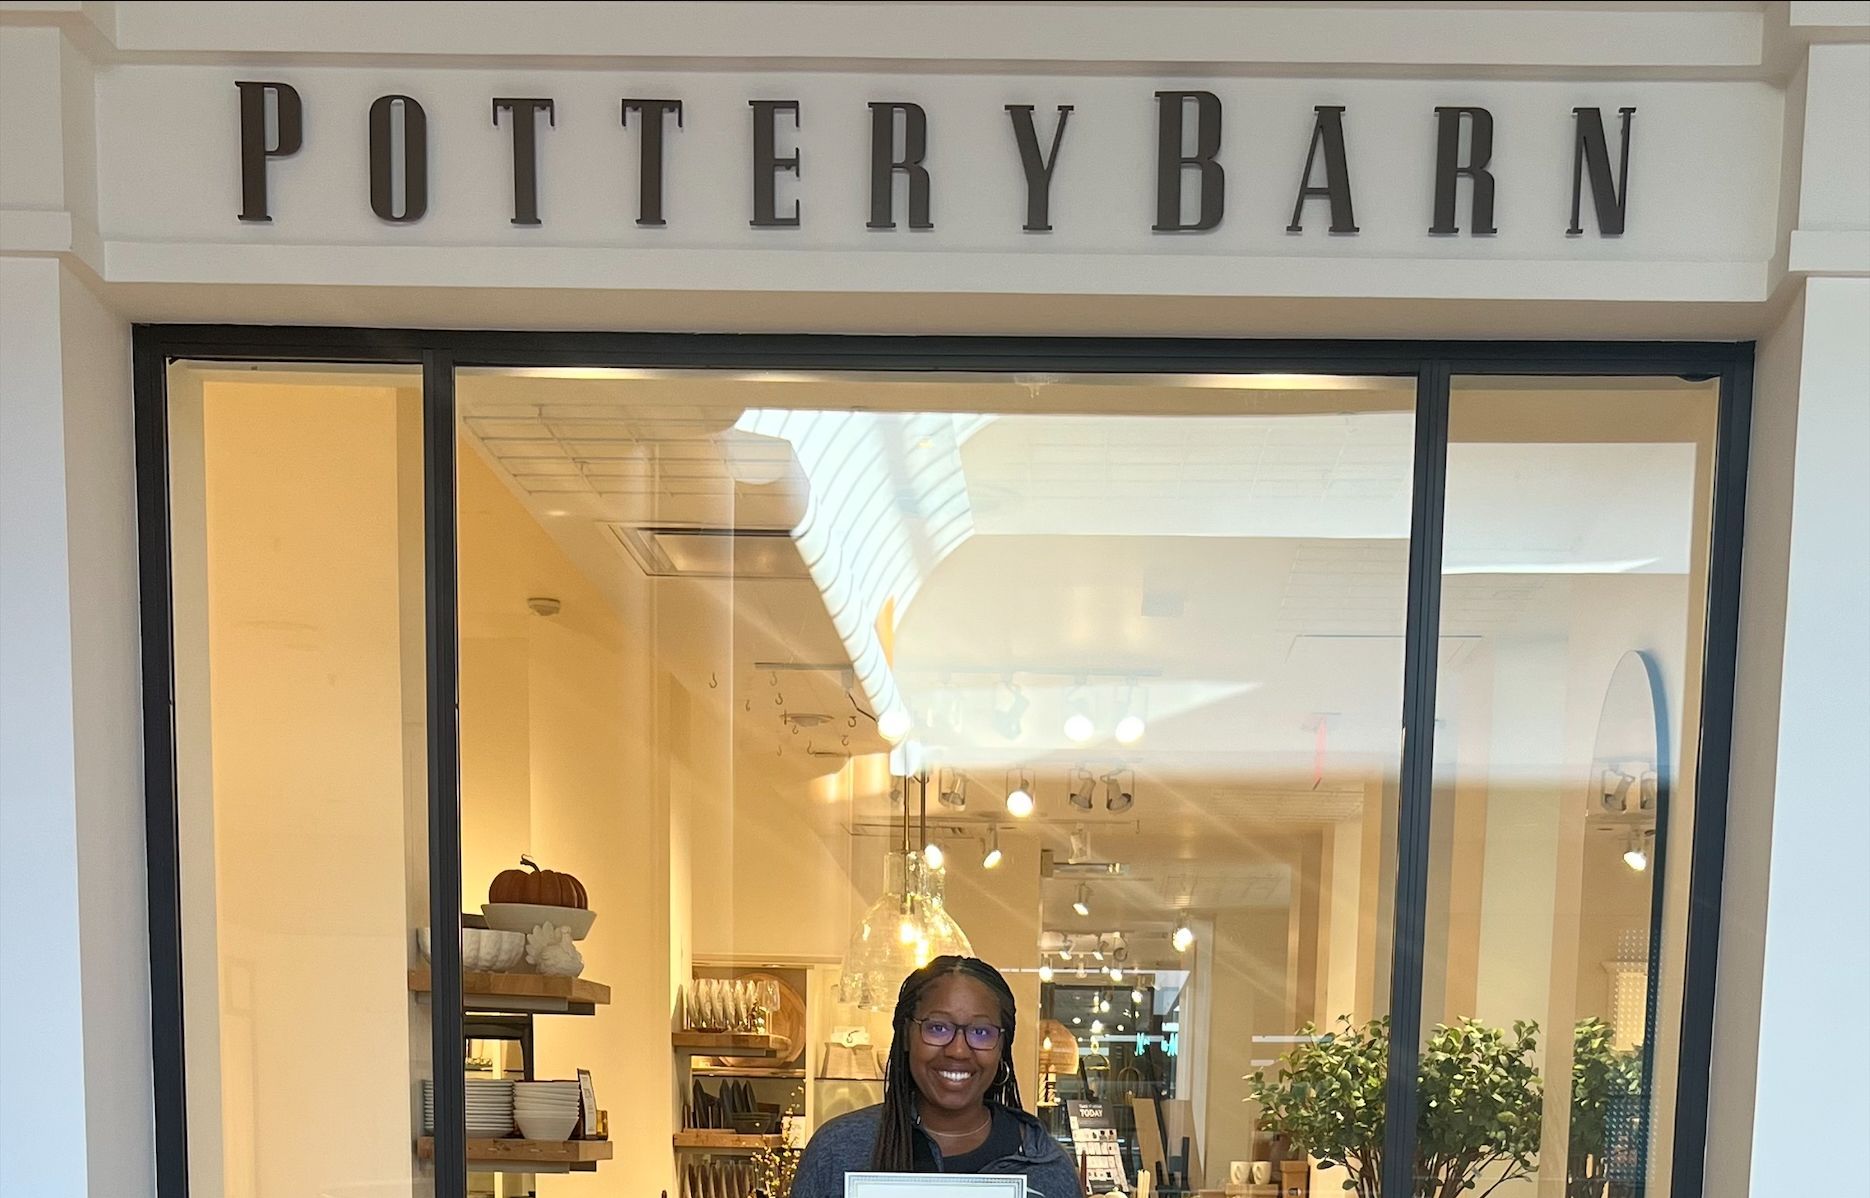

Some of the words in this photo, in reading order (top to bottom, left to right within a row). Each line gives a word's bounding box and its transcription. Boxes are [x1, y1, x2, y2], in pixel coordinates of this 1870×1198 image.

[235, 81, 1074, 230] POTTERY
[1152, 91, 1636, 234] BARN
[1079, 1108, 1103, 1118] TODAY
